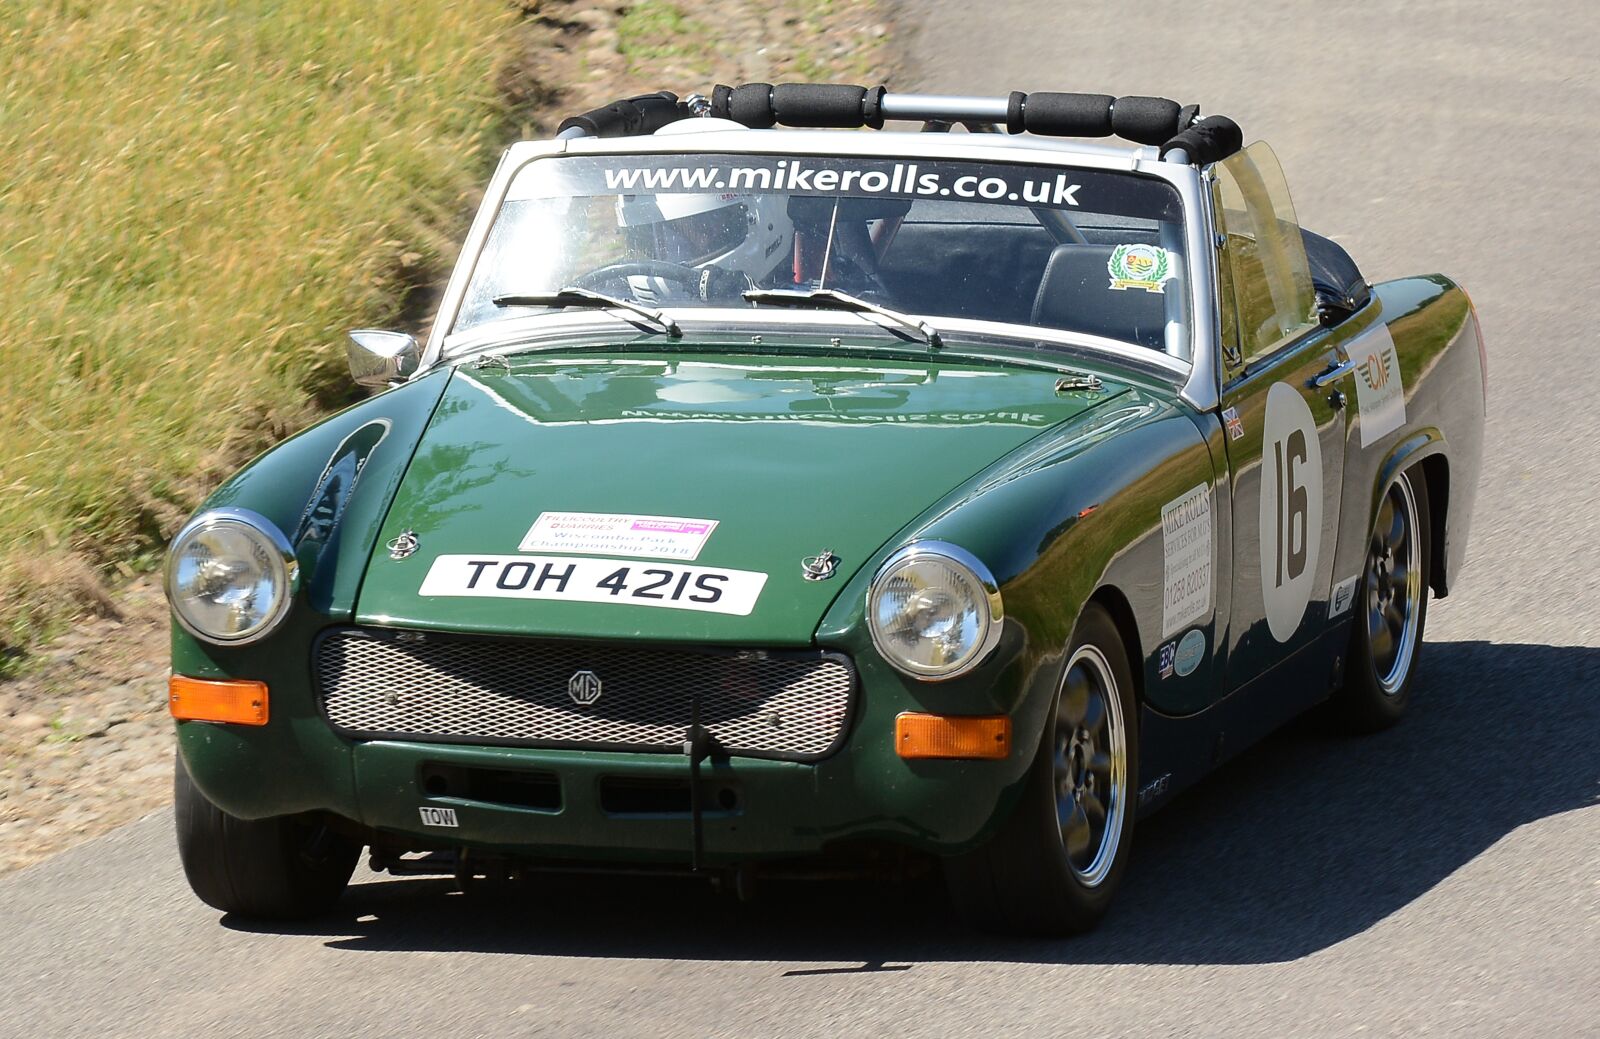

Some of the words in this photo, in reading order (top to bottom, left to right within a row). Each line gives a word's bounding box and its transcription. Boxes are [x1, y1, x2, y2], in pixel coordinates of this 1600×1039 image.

[604, 160, 1081, 206] www.mikerolls.co.uk
[1163, 504, 1184, 536] MIKE
[1183, 489, 1209, 524] ROLLS
[1274, 428, 1307, 588] 16
[465, 560, 577, 592] TOH
[596, 566, 730, 604] 421S
[572, 675, 597, 700] MG
[421, 808, 455, 825] TOW
